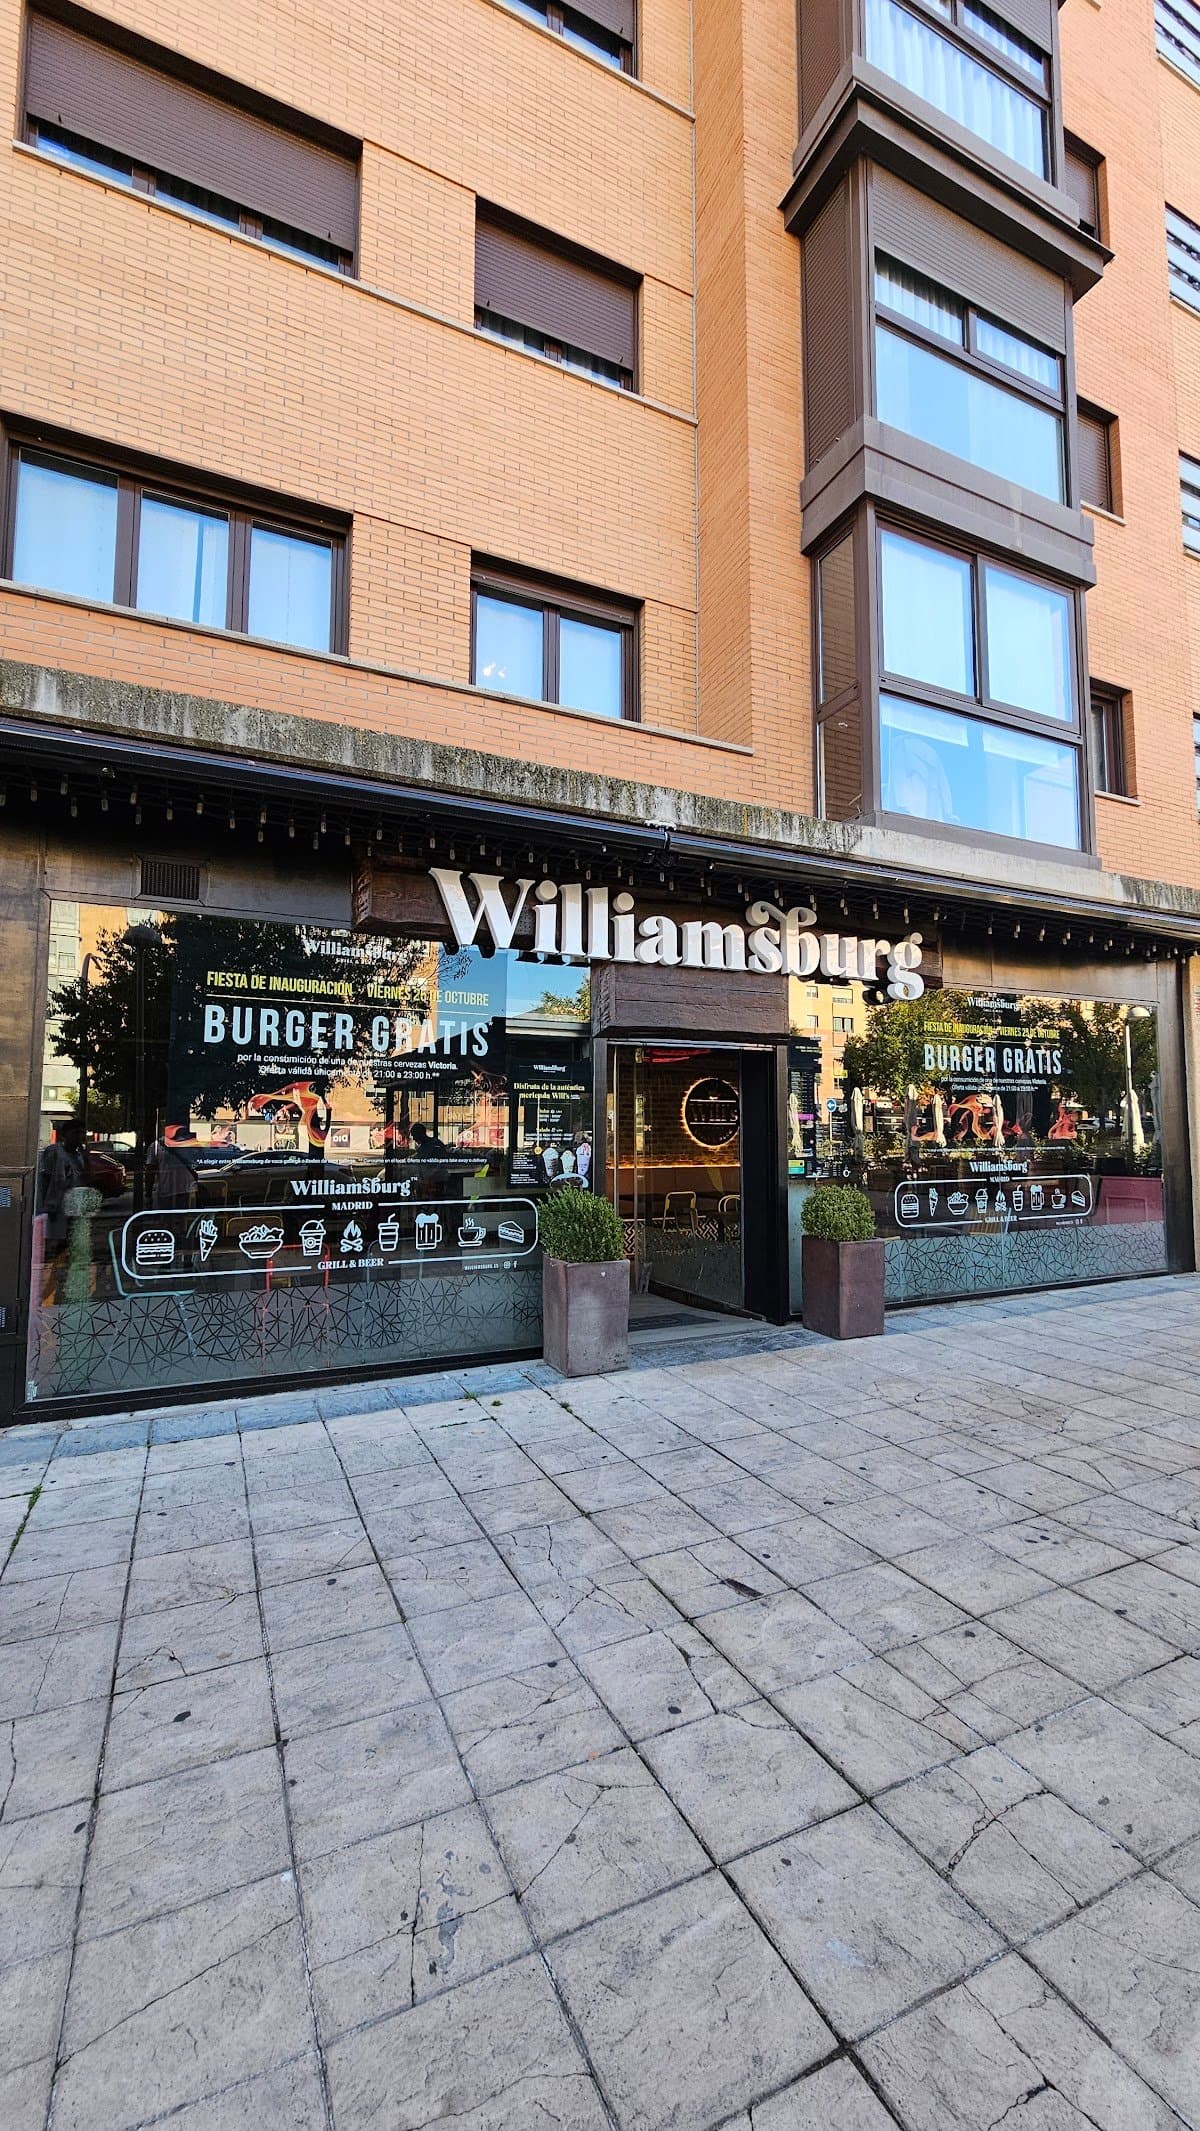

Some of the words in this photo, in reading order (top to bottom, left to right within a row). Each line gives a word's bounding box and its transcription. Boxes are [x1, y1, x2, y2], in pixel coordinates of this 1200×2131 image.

[428, 866, 925, 1001] Williamsburg
[303, 938, 408, 965] Williamsburg
[207, 970, 248, 988] FIESTA
[250, 974, 267, 990] DE
[269, 975, 353, 996] INAUGURACIÓN
[367, 983, 411, 1001] VIERNES
[429, 989, 443, 1003] DE
[445, 991, 489, 1007] OCTUBRE
[967, 996, 1019, 1011] Williamsburg
[203, 1004, 354, 1051] BURGER
[924, 1021, 943, 1033] FIESTA
[944, 1022, 953, 1033] DE
[1000, 1026, 1021, 1037] VIERNES
[237, 1053, 252, 1063] por
[253, 1053, 262, 1062] la
[263, 1054, 317, 1064] consumición
[318, 1056, 330, 1065] de
[331, 1057, 345, 1065] una
[347, 1058, 358, 1066] de
[359, 1058, 393, 1067] nuestras
[394, 1060, 427, 1069] cervezas
[428, 1060, 459, 1070] Victoria.
[924, 1044, 996, 1073] BURGER
[260, 1064, 287, 1075] Oferta
[288, 1066, 313, 1075] válida
[374, 1069, 396, 1079] 21:00
[396, 1071, 402, 1079] a
[403, 1070, 425, 1080] 23:00
[513, 1082, 541, 1090] Disfruta
[541, 1082, 549, 1091] de
[550, 1082, 556, 1091] la
[556, 1083, 586, 1091] auténtica
[519, 1091, 551, 1099] merienda
[331, 1201, 374, 1211] MADRID
[317, 1260, 348, 1271] GRILL
[348, 1259, 357, 1269] &
[357, 1258, 385, 1268] BEER
